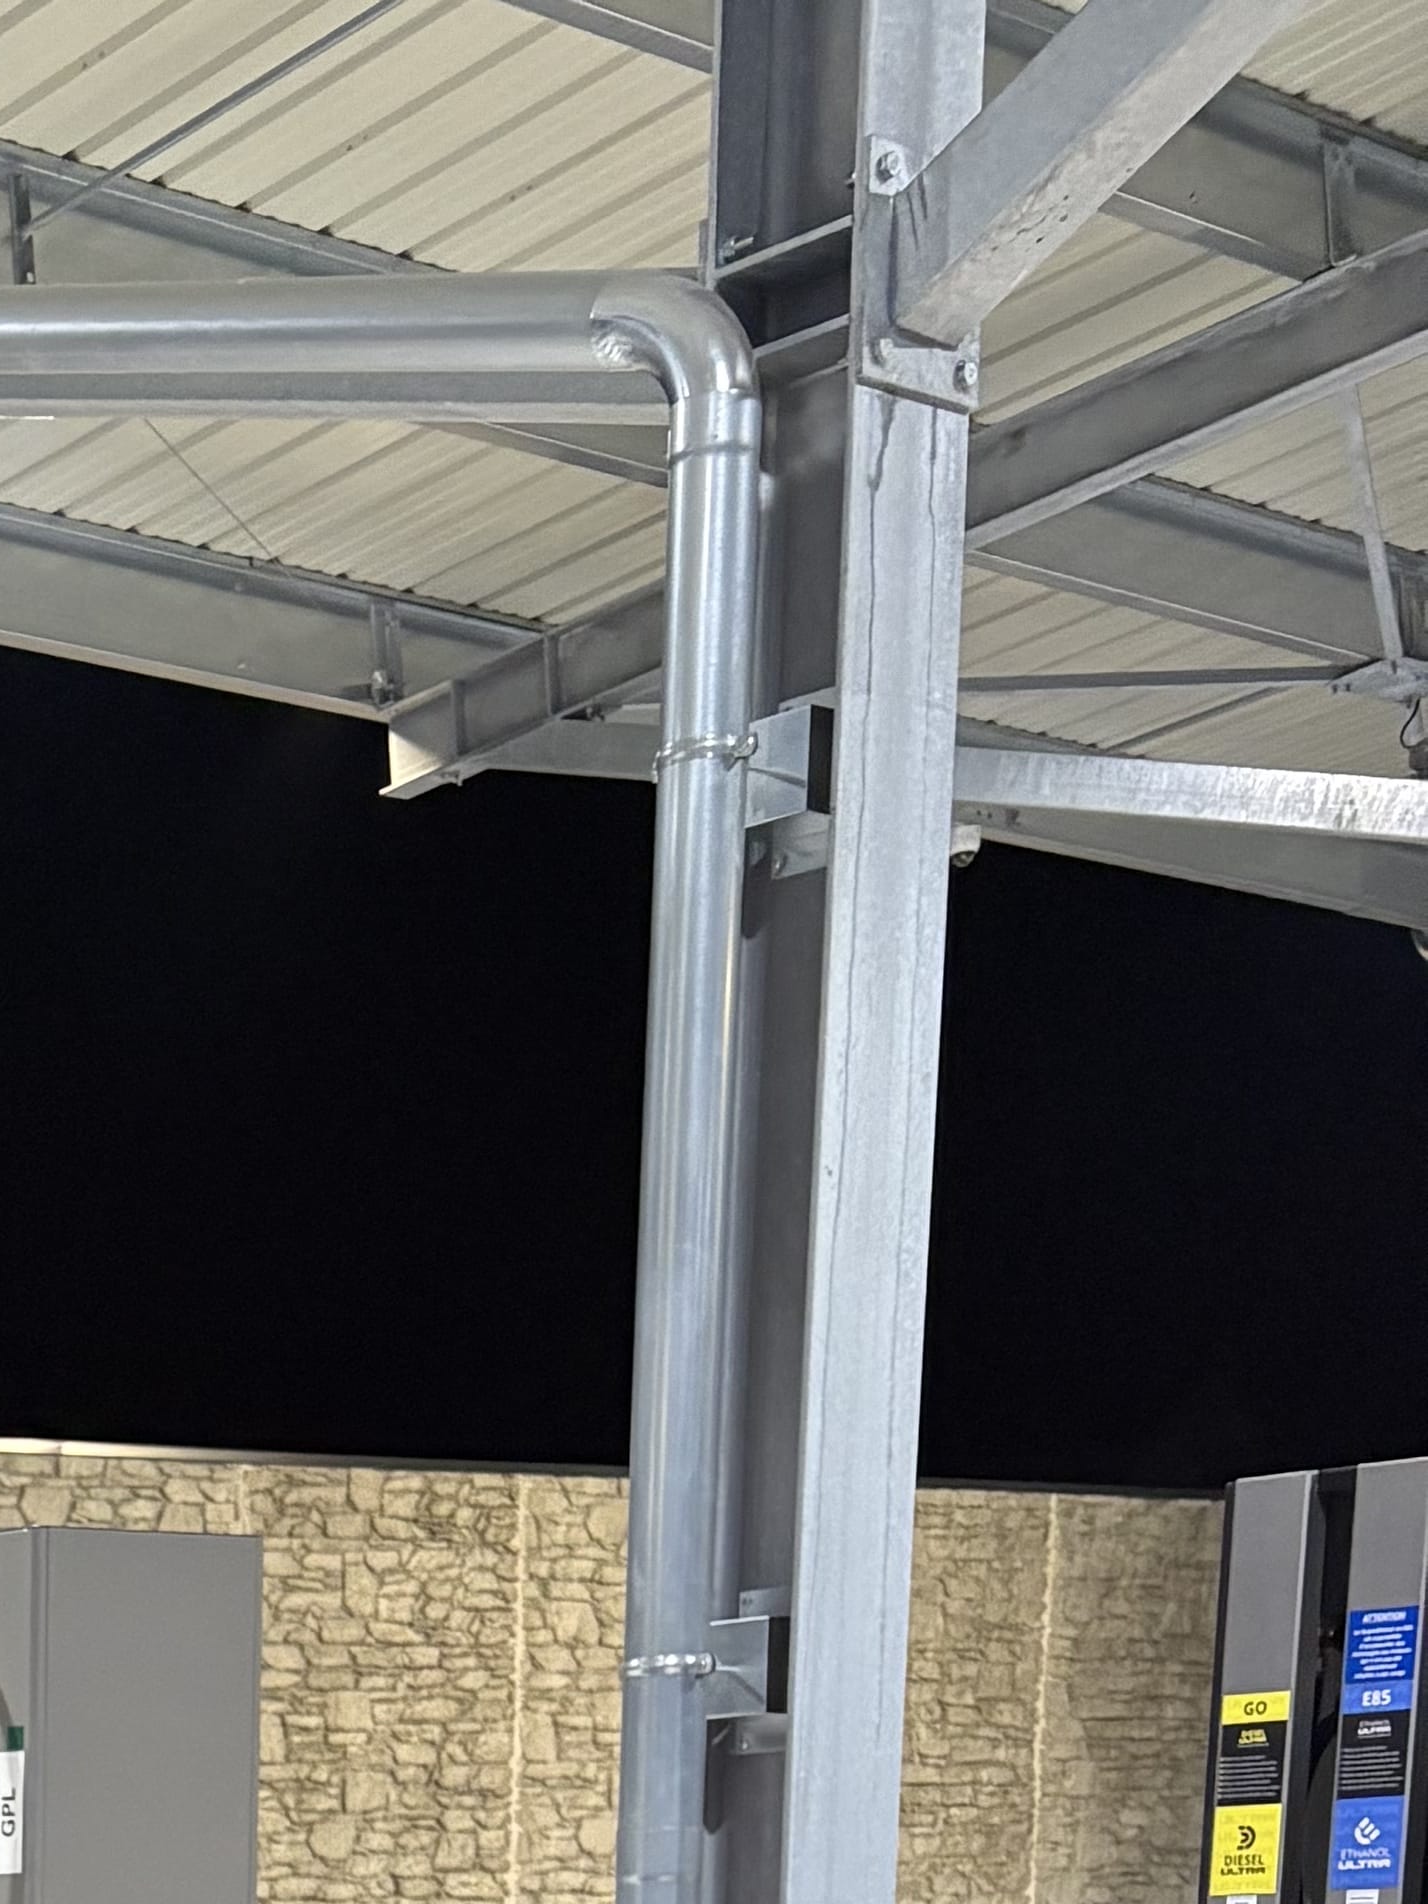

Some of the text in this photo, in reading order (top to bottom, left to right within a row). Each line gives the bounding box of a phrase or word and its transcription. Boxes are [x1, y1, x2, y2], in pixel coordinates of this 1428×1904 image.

[1361, 1689, 1392, 1707] E85
[1243, 1701, 1268, 1716] GO
[0, 1787, 17, 1837] GPL
[1223, 1853, 1265, 1866] DIESEL
[1337, 1858, 1392, 1871] ULTRA
